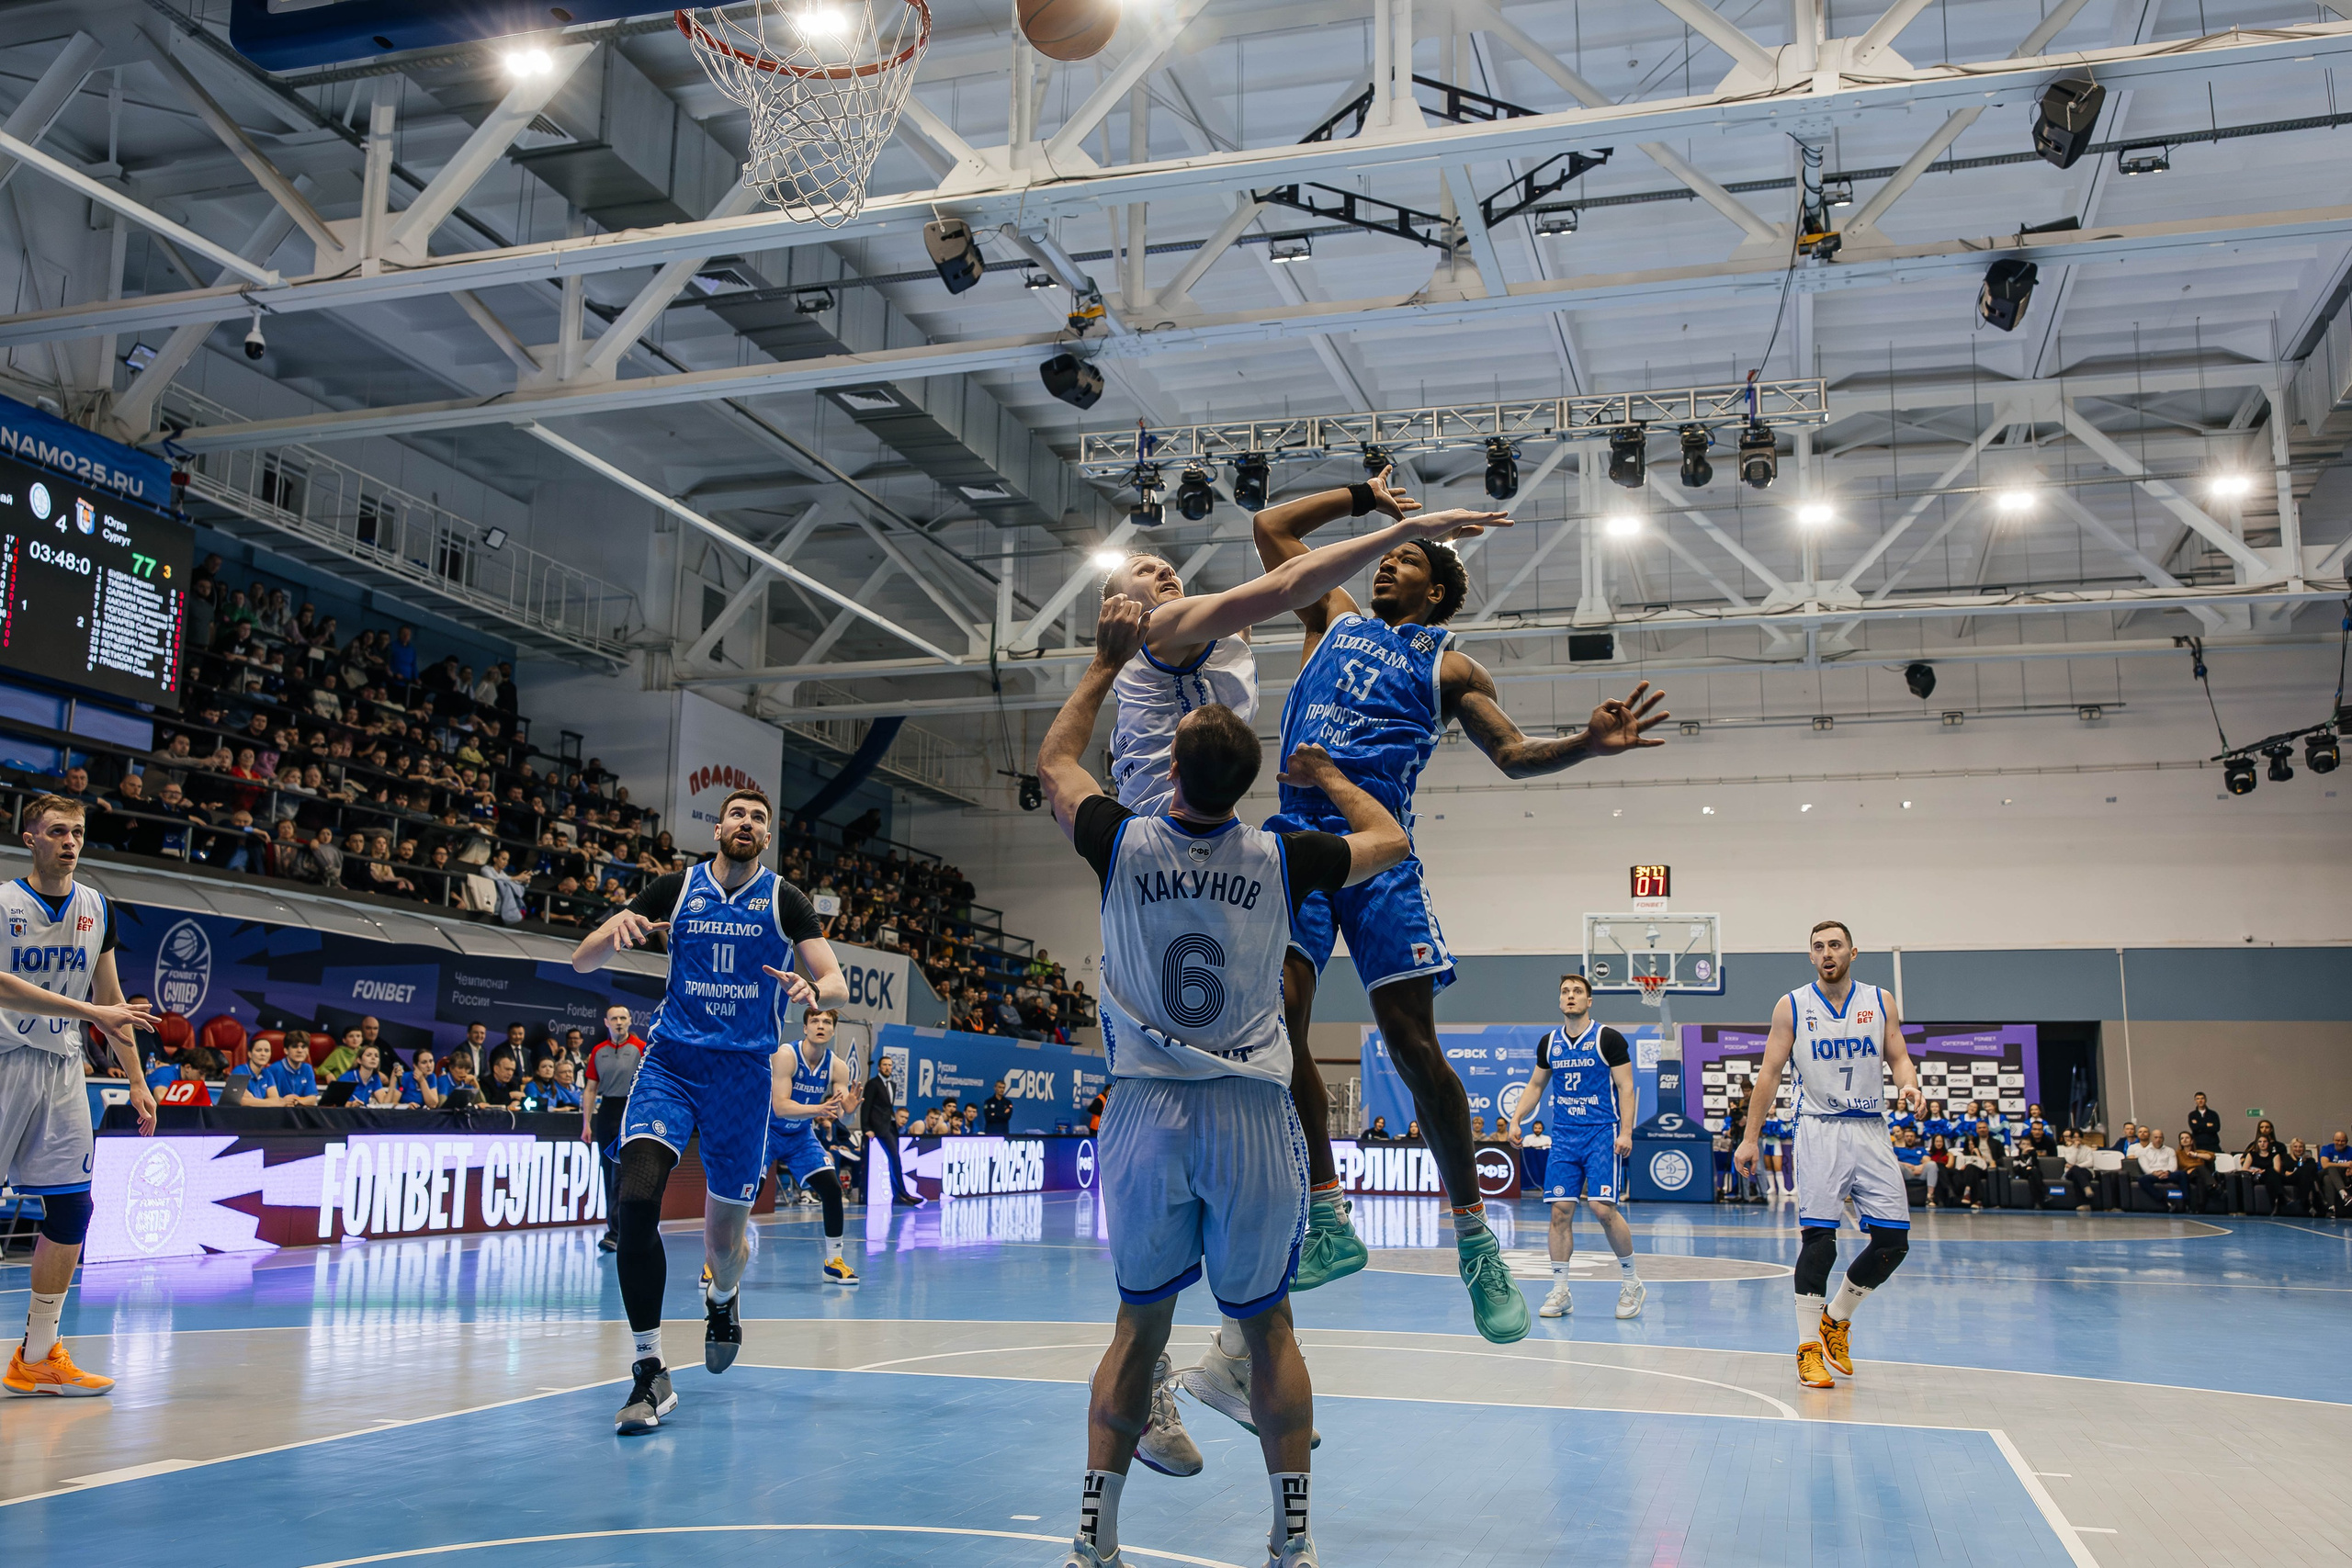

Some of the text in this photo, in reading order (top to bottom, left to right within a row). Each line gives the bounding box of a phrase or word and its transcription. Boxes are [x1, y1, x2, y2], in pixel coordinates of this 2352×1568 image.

[55, 514, 68, 533] 4
[103, 514, 128, 532] Югра
[6, 534, 15, 544] 17
[102, 528, 131, 547] Сургут
[13, 547, 18, 555] 4
[29, 540, 91, 575] 03:48:0
[132, 552, 157, 578] 77
[163, 564, 172, 579] 3
[107, 568, 131, 581] БУДИН
[9, 592, 14, 601] 0
[105, 595, 138, 612] ХАКУНОВ
[22, 600, 28, 611] 1
[6, 620, 11, 628] 0
[76, 616, 85, 628] 2
[5, 629, 10, 638] 0
[1415, 631, 1436, 650] FON
[4, 638, 8, 648] 0
[1410, 638, 1430, 654] BET
[1336, 659, 1381, 701] 53
[1191, 847, 1209, 856] РФБ
[1135, 870, 1261, 910] ХАКУНОВ
[1636, 876, 1664, 897] 07
[77, 923, 92, 931] BET
[79, 916, 94, 924] FON
[687, 919, 763, 937] ДИНАМО
[10, 945, 87, 973] ЮГРА
[712, 942, 735, 974] 10
[455, 972, 508, 989] Чемпионат
[684, 980, 759, 998] ПРИМОРСКИЙ
[849, 965, 896, 1010] ВСК
[1161, 932, 1226, 1029] 6
[164, 981, 198, 1002] СУПЕР
[352, 979, 416, 1004] FONBET
[452, 990, 490, 1007] России
[567, 1003, 596, 1019] Fonbet
[706, 1000, 736, 1016] КРАЙ
[1464, 1049, 1487, 1059] ВСК
[1811, 1035, 1879, 1061] ЮГРА
[1552, 1058, 1595, 1069] ДИНАМО
[1026, 1070, 1055, 1101] ВСК
[1565, 1072, 1582, 1091] 27
[1659, 1074, 1679, 1082] FON
[1659, 1081, 1679, 1089] BET
[1839, 1066, 1853, 1091] 7
[164, 1083, 195, 1102] 5
[1568, 1105, 1587, 1116] КРАЙ
[1847, 1096, 1878, 1110] Utair
[942, 1140, 1045, 1195] СЕЗОН 2025/26
[1333, 1147, 1441, 1192] ЕРЛИГА
[1476, 1164, 1509, 1179] РФБ
[318, 1141, 606, 1238] FONBET СУПЕРЛ
[1848, 1287, 1863, 1297] 23
